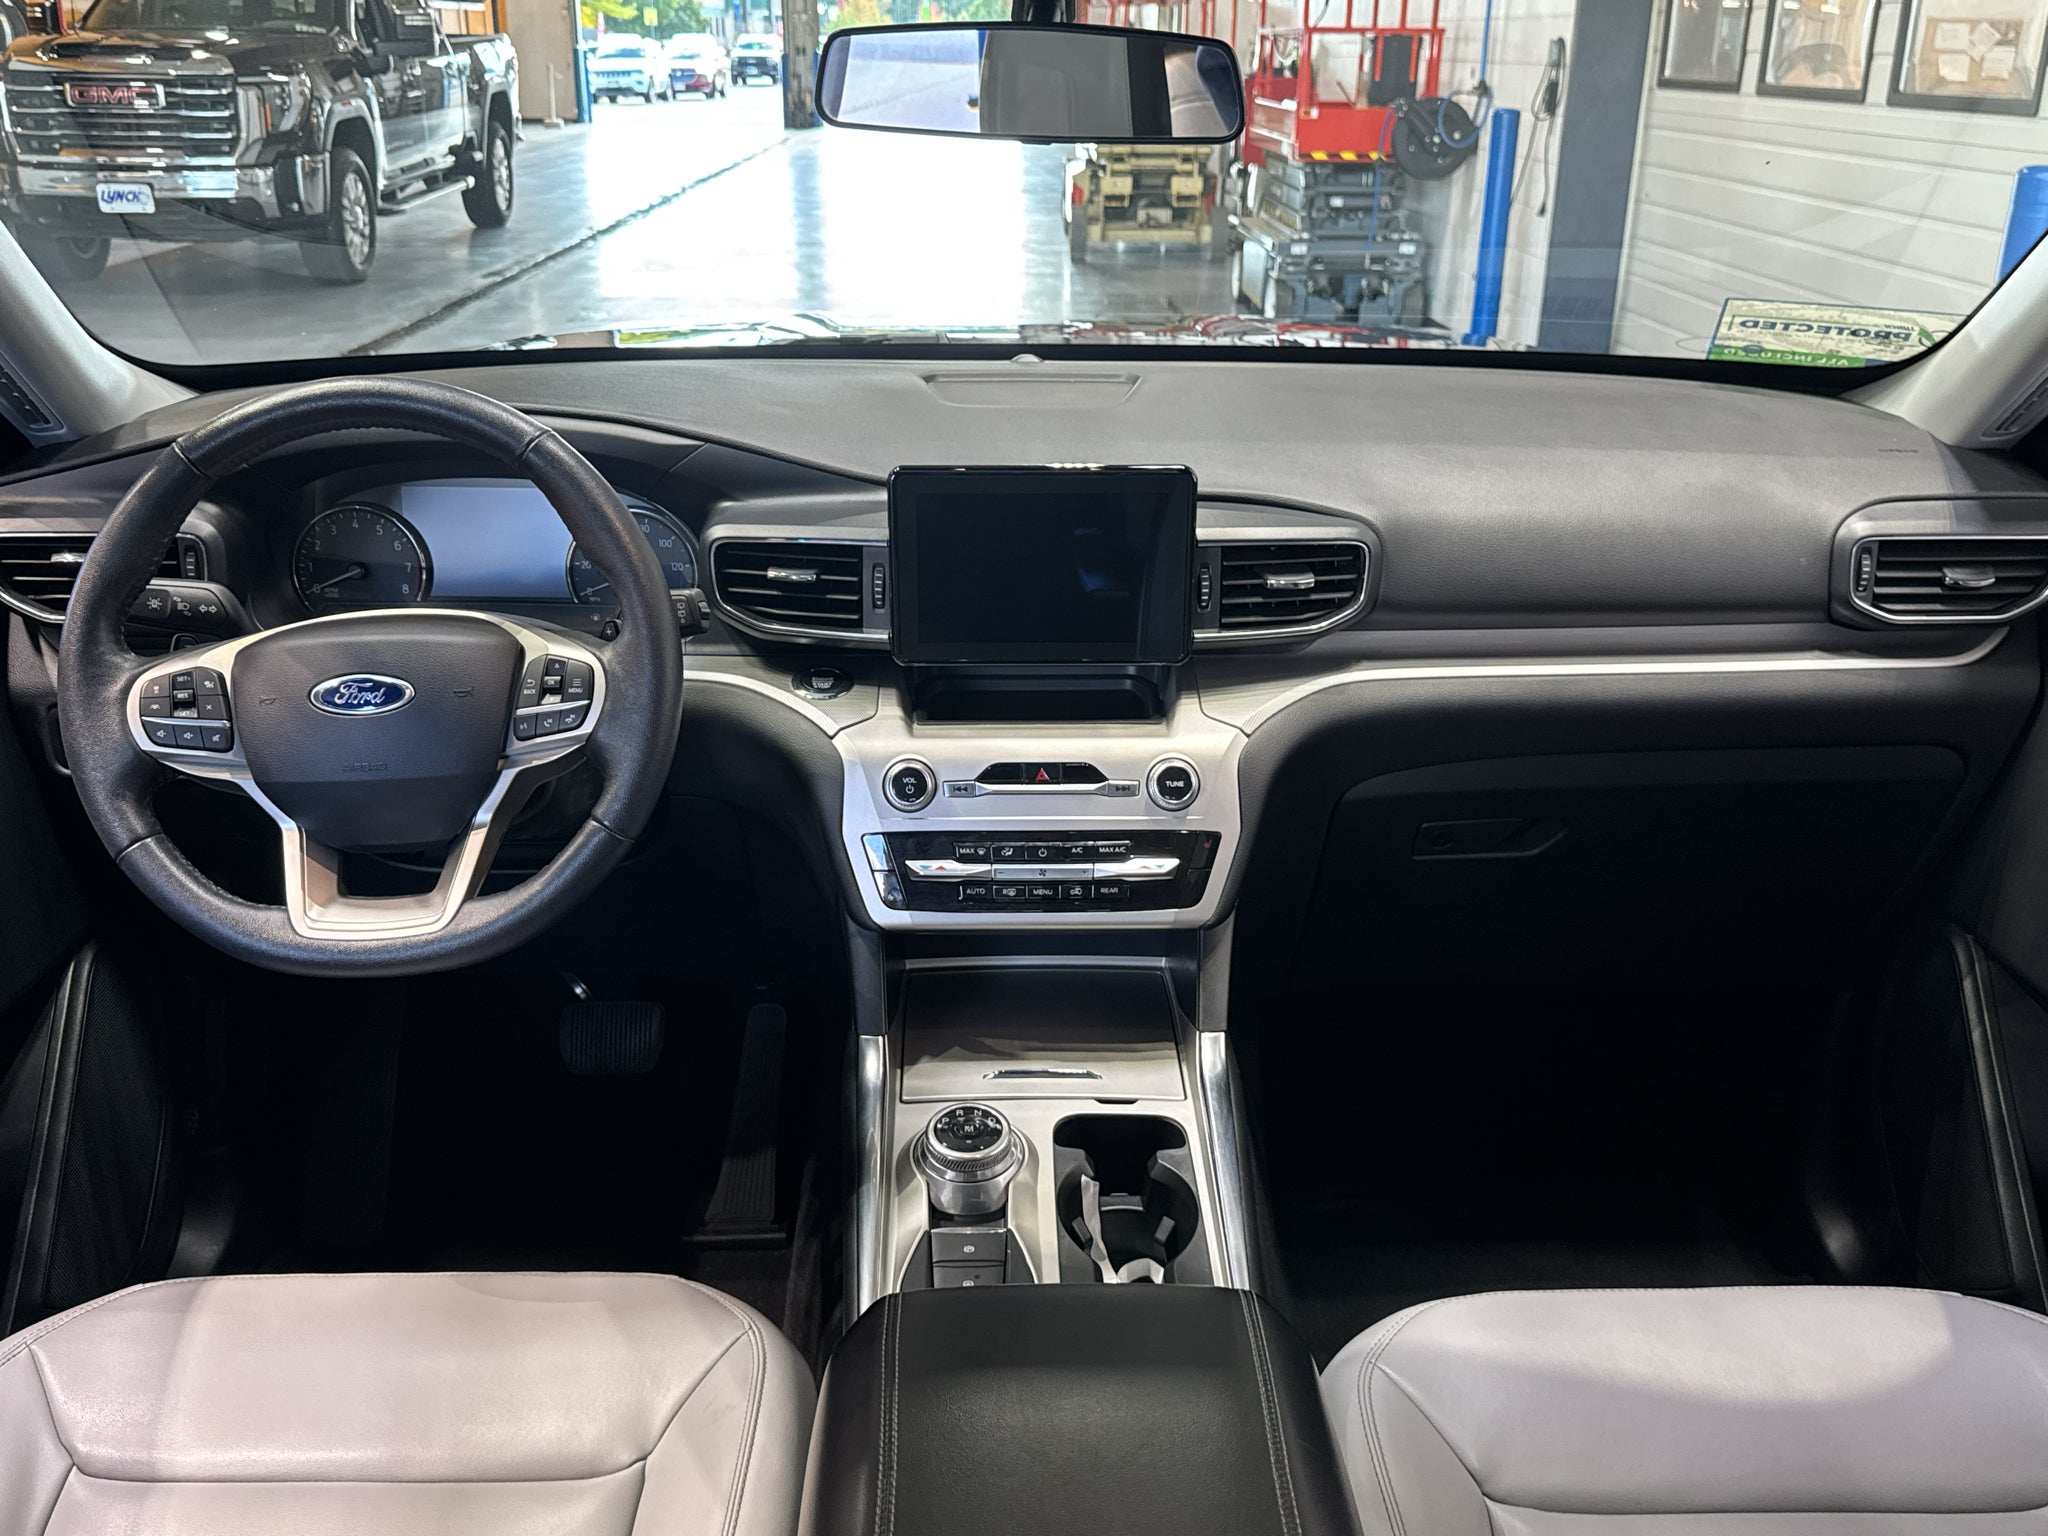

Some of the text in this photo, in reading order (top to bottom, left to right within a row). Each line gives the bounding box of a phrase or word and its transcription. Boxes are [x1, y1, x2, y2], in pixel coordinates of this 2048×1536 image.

[71, 86, 157, 104] GMC
[352, 519, 359, 529] 4
[330, 524, 337, 536] 3
[376, 524, 383, 536] 5
[314, 540, 321, 551] 2
[394, 541, 402, 551] 6
[658, 539, 673, 548] 100
[405, 562, 412, 573] 7
[580, 560, 592, 570] 20
[671, 562, 684, 571] 120
[402, 583, 410, 594] 8
[334, 681, 387, 705] Ford
[964, 1125, 974, 1133] M
